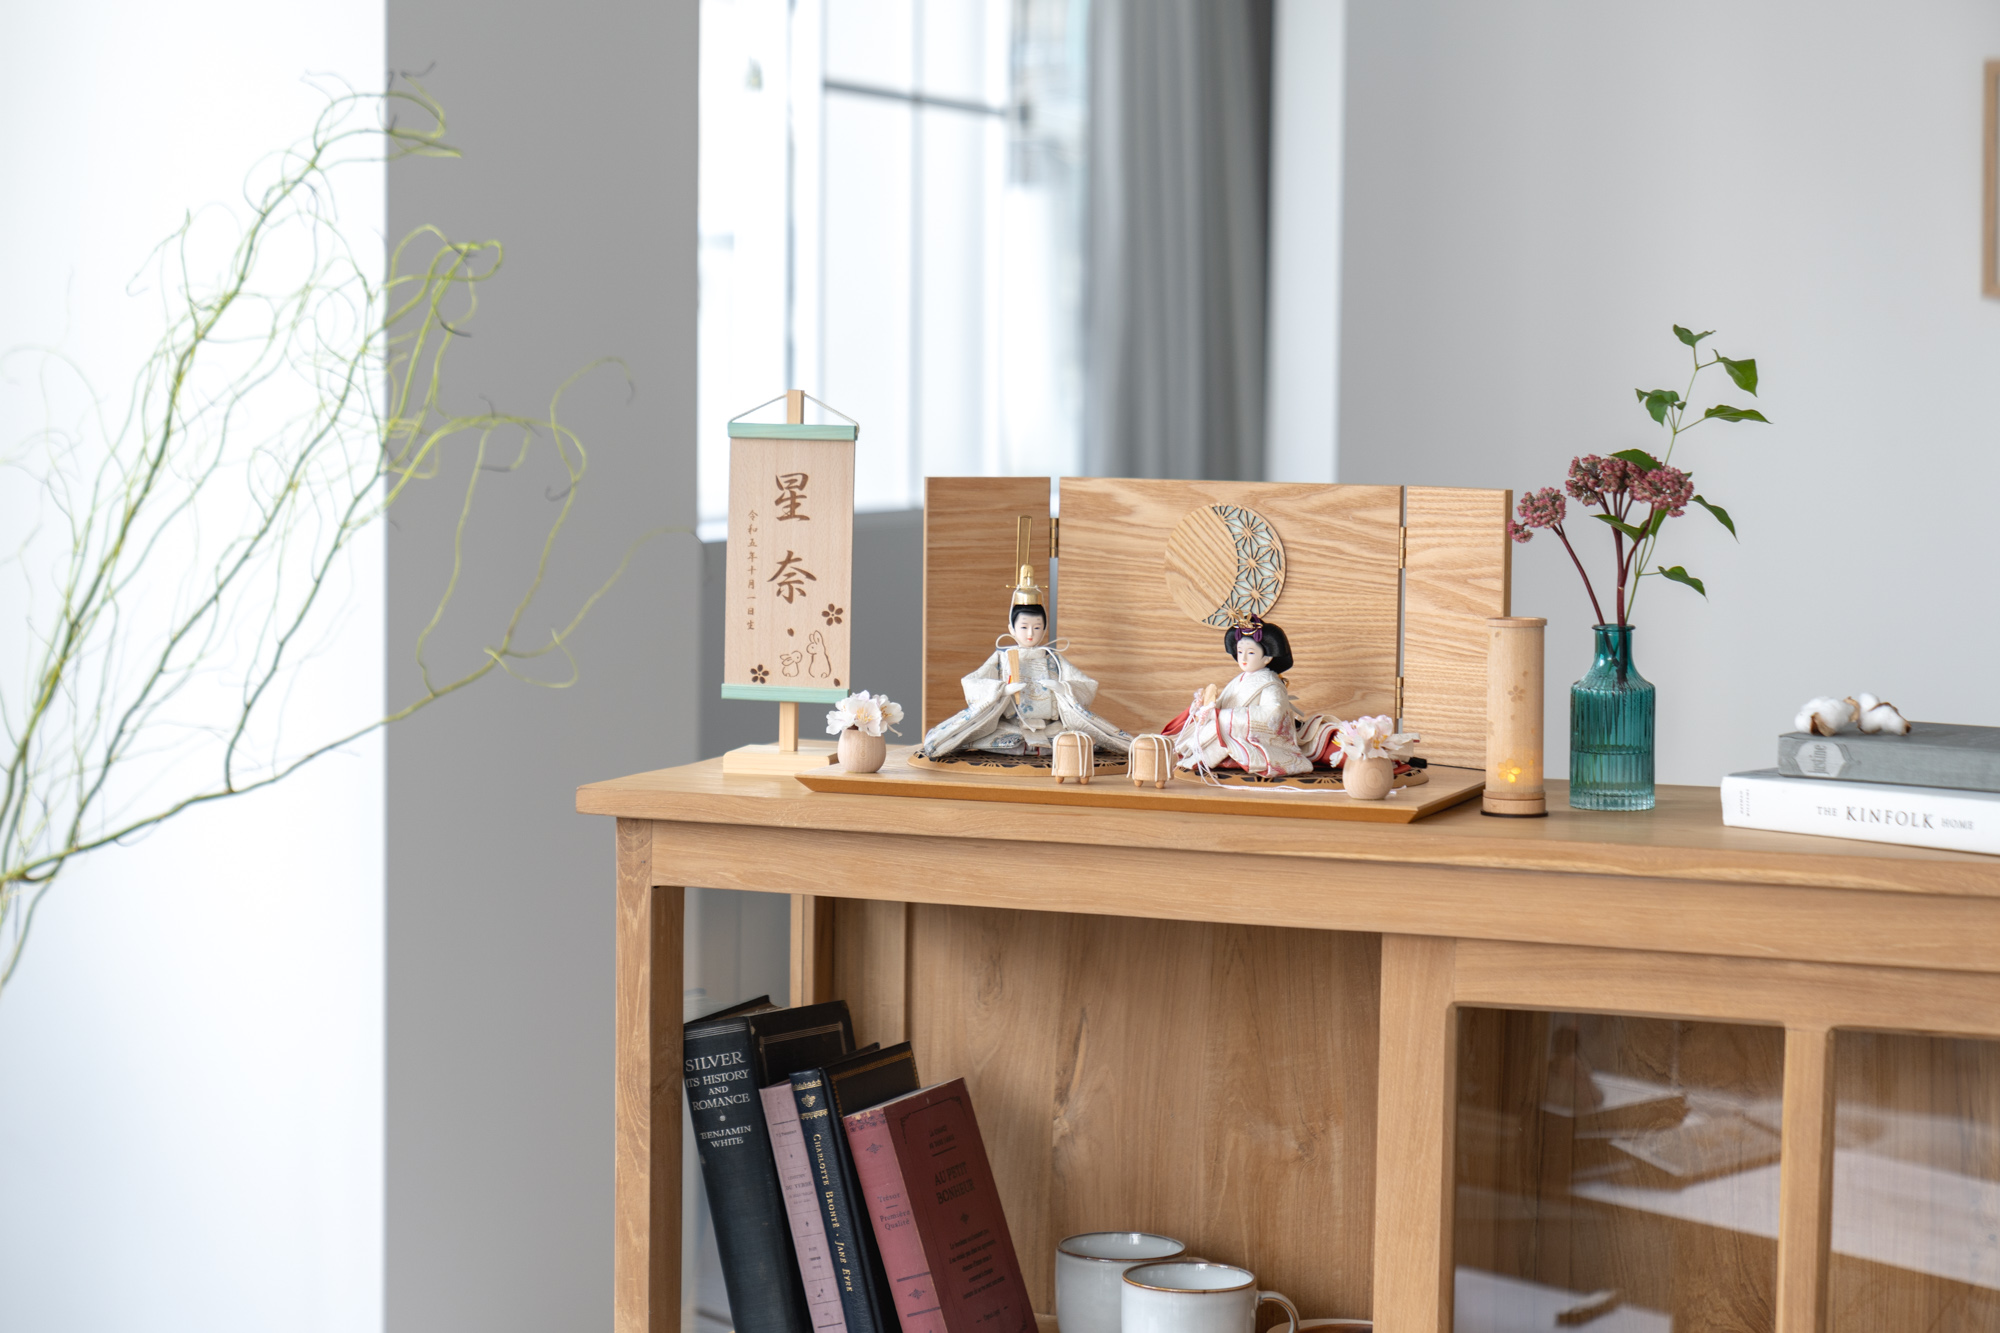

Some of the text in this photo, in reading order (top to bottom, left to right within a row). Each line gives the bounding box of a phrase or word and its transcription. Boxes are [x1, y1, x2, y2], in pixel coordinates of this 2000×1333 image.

[767, 472, 817, 604] 星奈
[747, 509, 758, 631] 令和五年十月一日生
[1808, 744, 1830, 775] Justine
[1816, 806, 1975, 831] THE KINFOLK HOME
[685, 1051, 746, 1072] SILVER
[703, 1069, 750, 1086] HISTORY
[708, 1085, 729, 1096] AND
[692, 1093, 751, 1111] ROMANCE
[701, 1125, 752, 1140] BENJAMIN
[711, 1137, 744, 1148] WHITE
[877, 1192, 901, 1204] Trésor
[936, 1177, 976, 1205] BONHEUR
[879, 1209, 911, 1223] Première
[884, 1218, 911, 1232] Qualité
[834, 1240, 853, 1292] JANE EYRE
